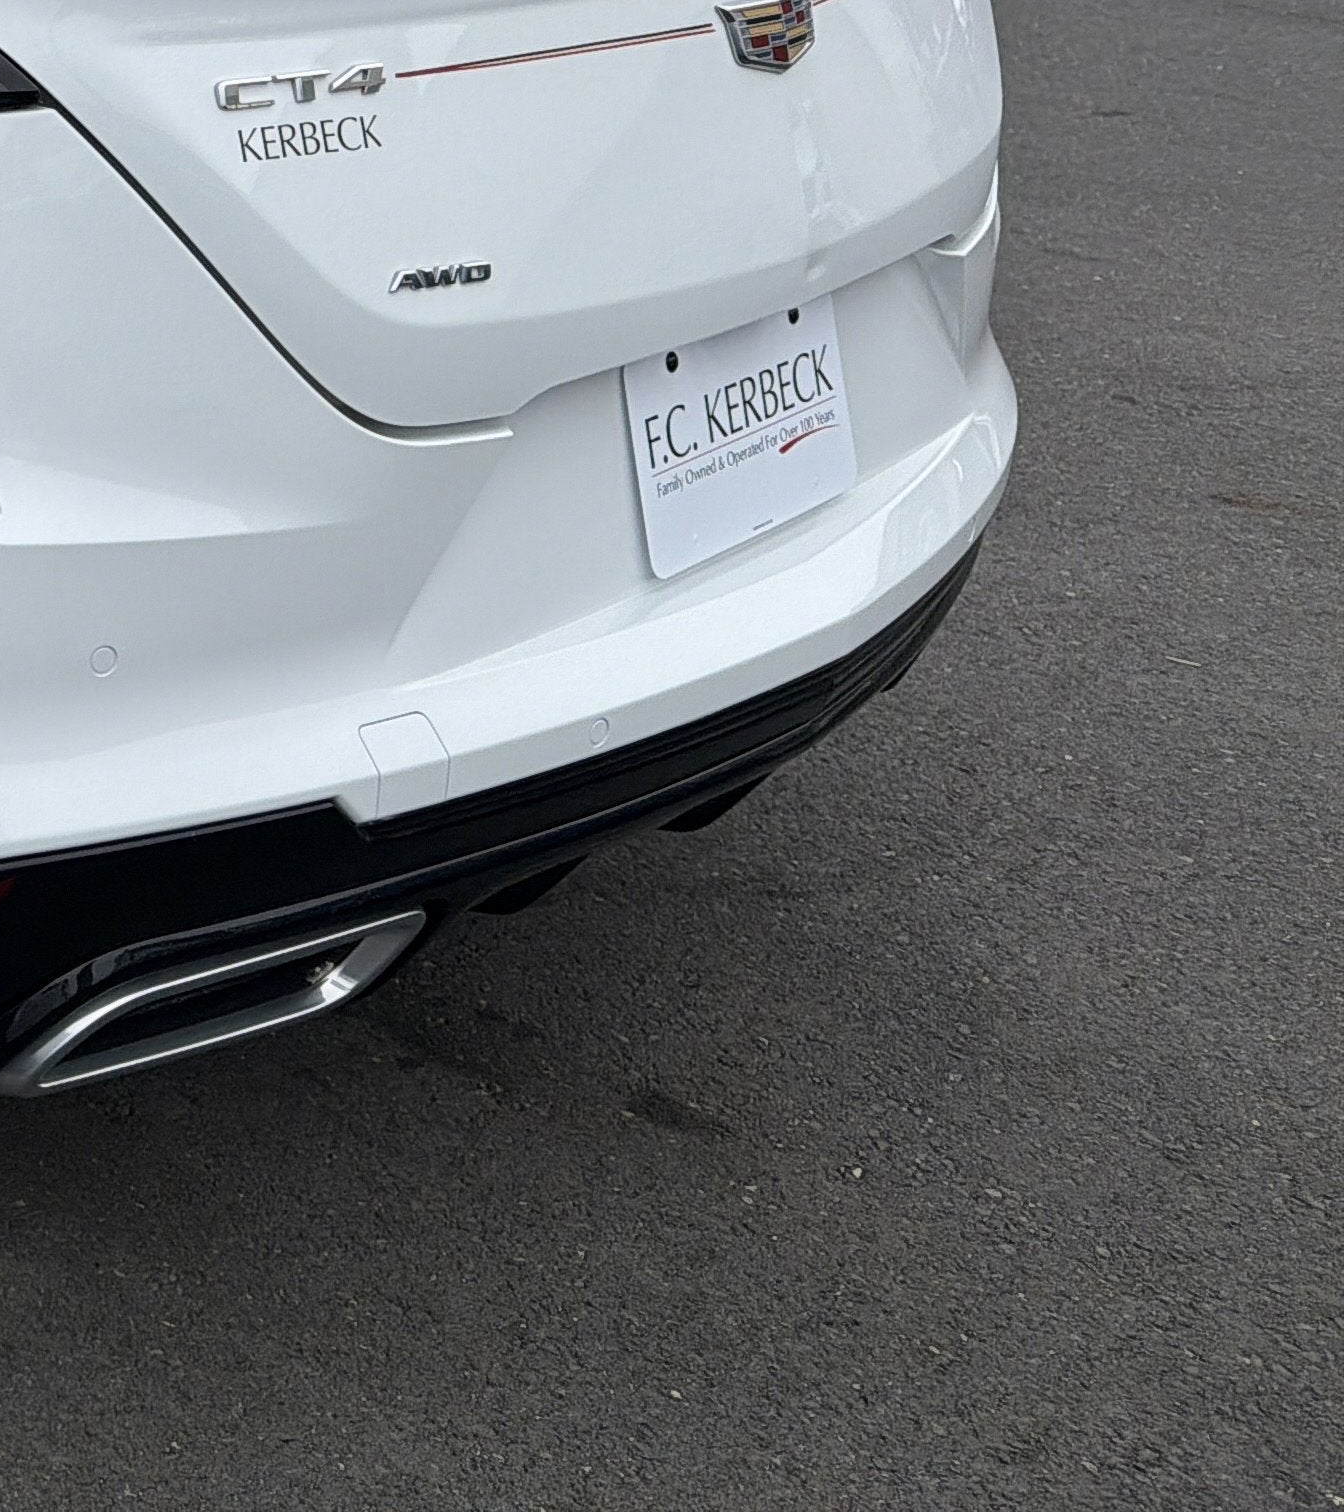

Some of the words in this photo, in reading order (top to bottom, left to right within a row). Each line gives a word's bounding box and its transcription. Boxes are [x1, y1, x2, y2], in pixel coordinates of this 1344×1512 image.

[214, 61, 387, 111] CT4
[237, 114, 383, 163] KERBECK
[388, 260, 492, 294] AWD
[644, 404, 699, 469] F.C.
[703, 344, 835, 443] KERBECK
[656, 474, 684, 498] Family
[685, 457, 717, 485] Owned
[718, 457, 726, 471] &
[726, 442, 764, 468] Operated
[765, 434, 779, 450] For
[779, 425, 799, 443] Over
[799, 417, 814, 433] 100
[814, 408, 836, 426] Years
